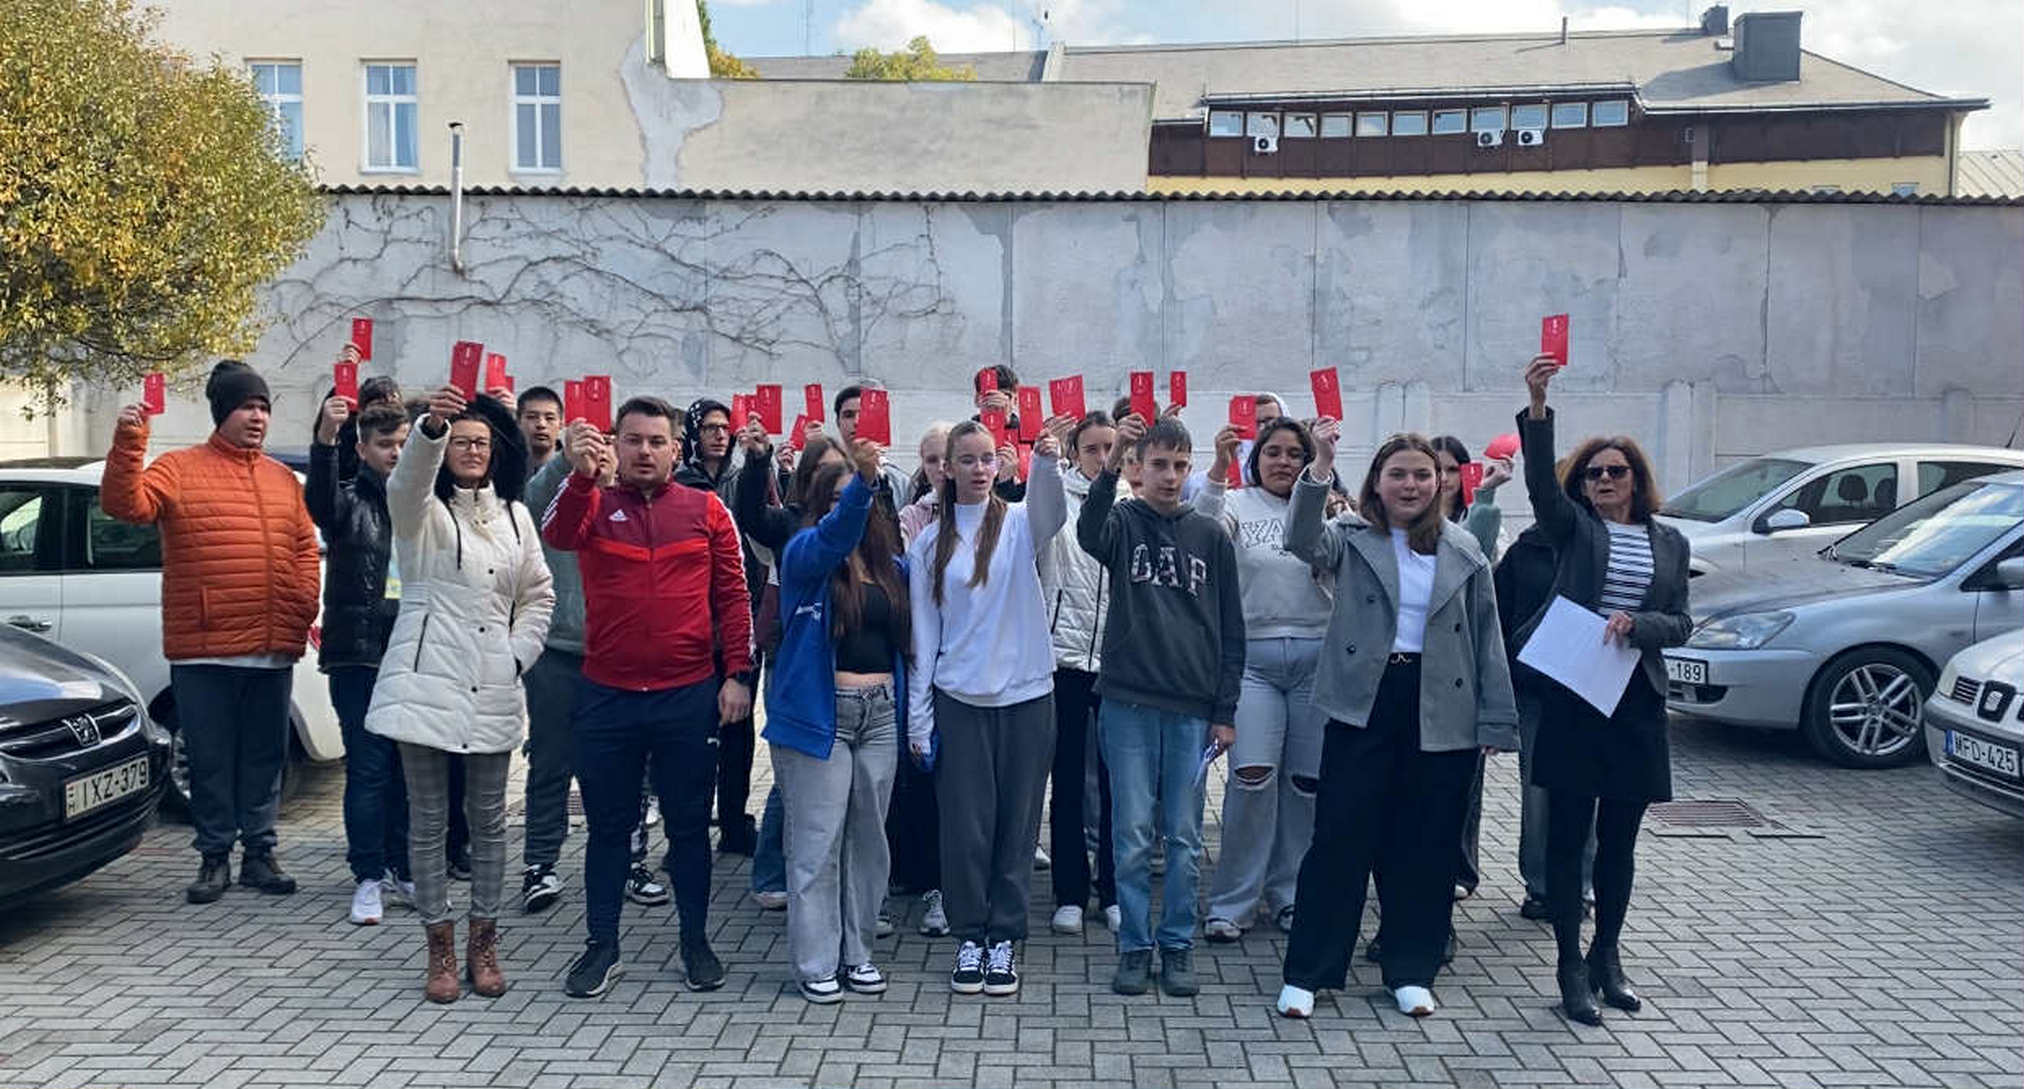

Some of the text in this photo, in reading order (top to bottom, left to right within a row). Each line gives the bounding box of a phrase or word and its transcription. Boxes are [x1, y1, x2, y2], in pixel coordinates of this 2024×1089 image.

[1240, 519, 1285, 549] YA
[1131, 543, 1206, 597] GAP
[1671, 662, 1701, 682] -189
[1954, 735, 2015, 772] MFD-425
[83, 761, 147, 808] IXZ-379
